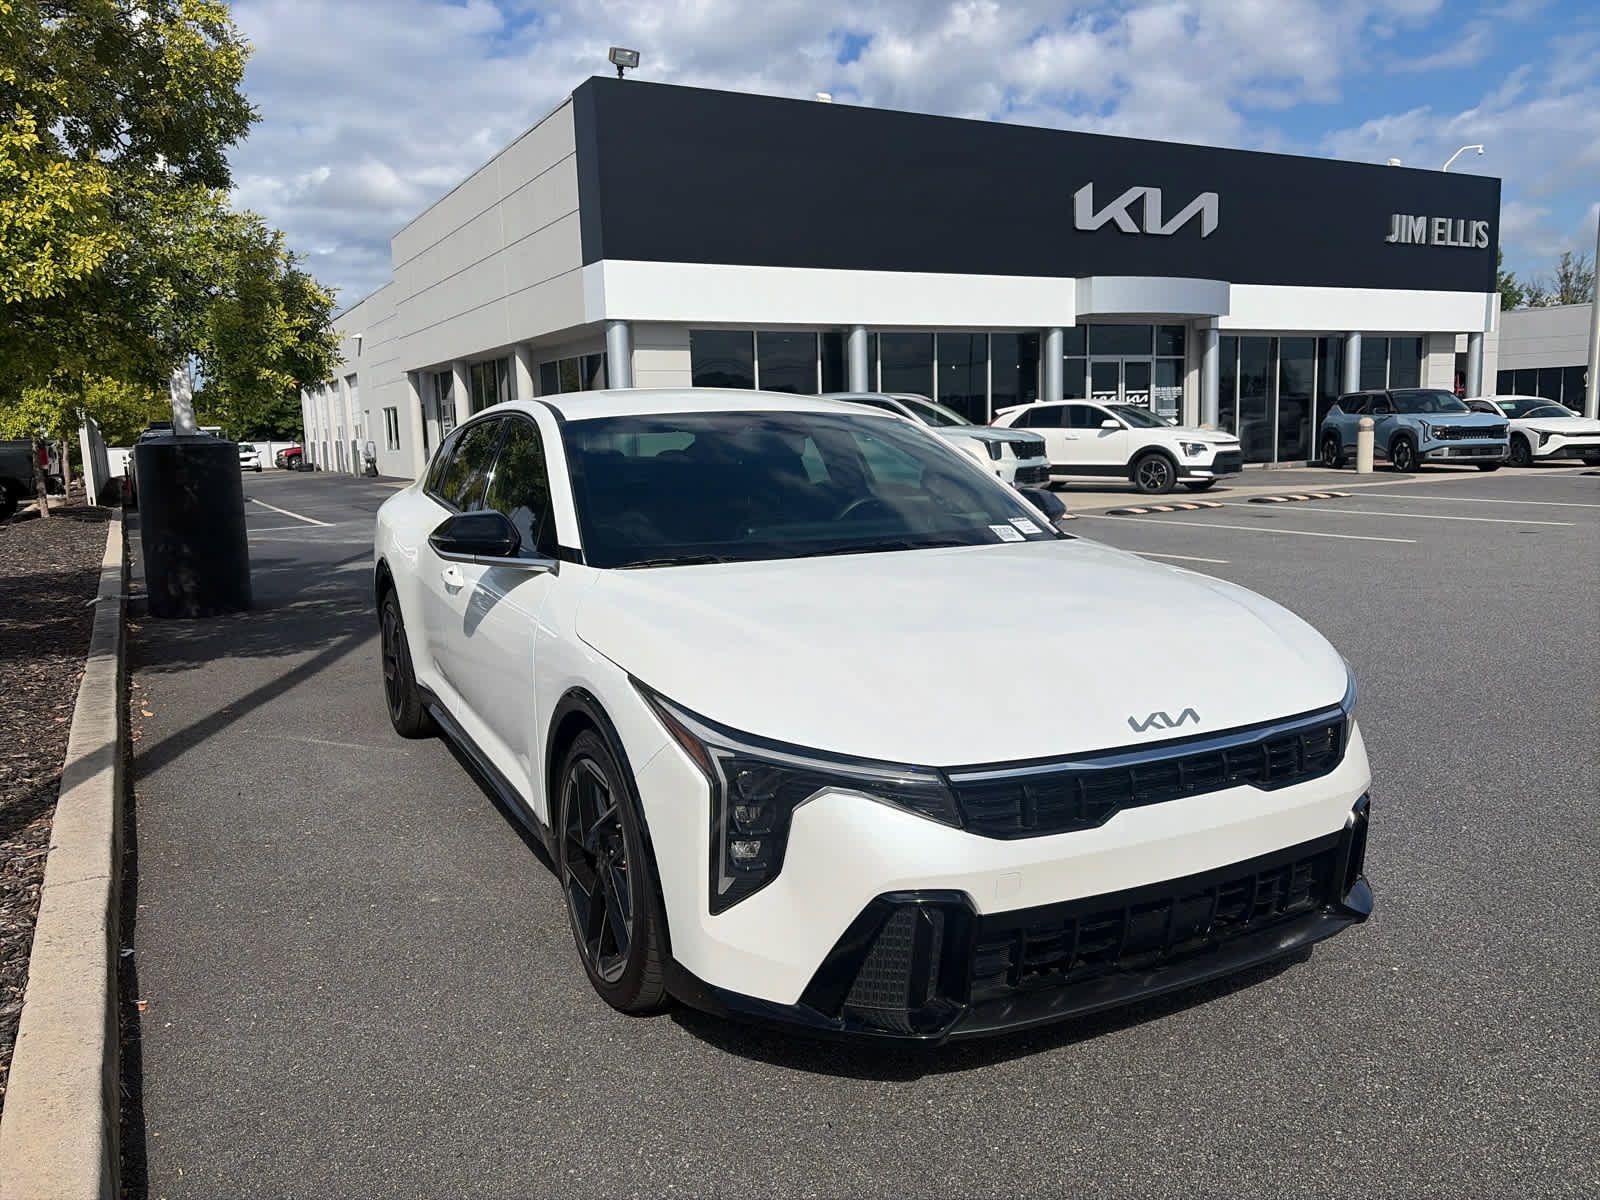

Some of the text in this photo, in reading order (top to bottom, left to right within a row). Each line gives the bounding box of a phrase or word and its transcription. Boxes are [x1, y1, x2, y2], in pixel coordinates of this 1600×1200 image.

[1074, 182, 1218, 238] KIA
[1385, 214, 1489, 248] JIM ELLIS
[1128, 708, 1200, 732] KIA
